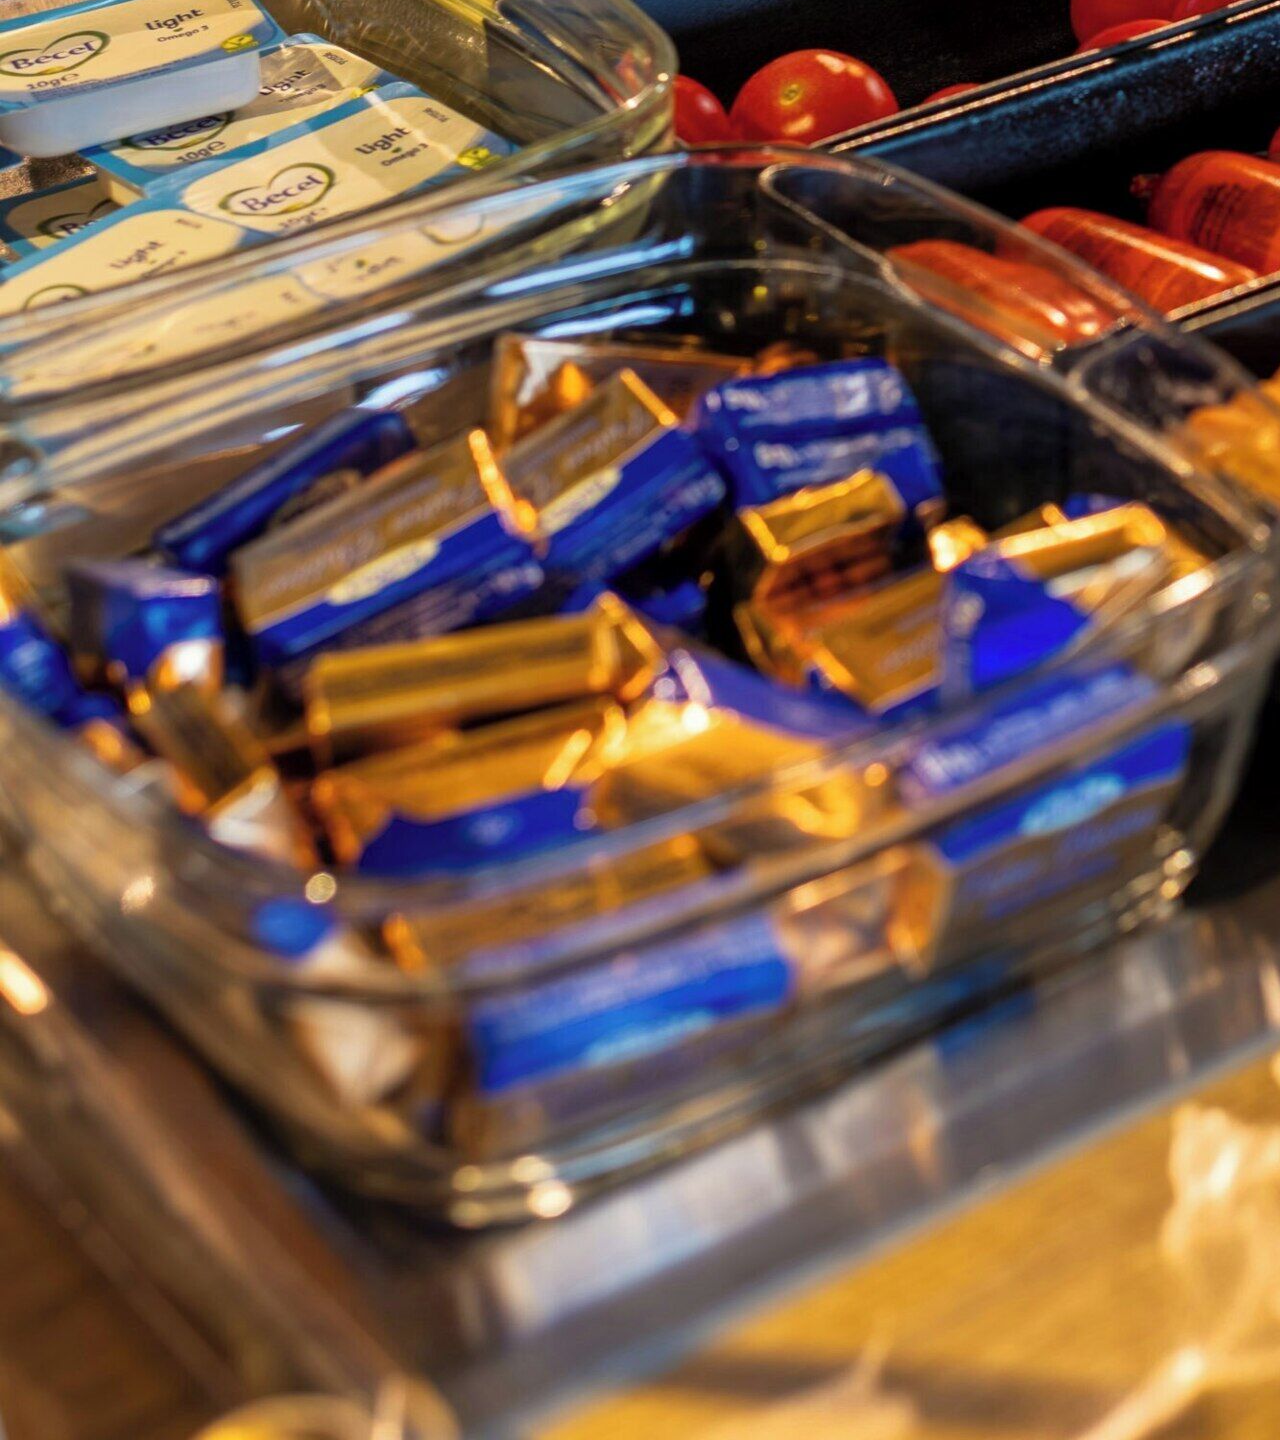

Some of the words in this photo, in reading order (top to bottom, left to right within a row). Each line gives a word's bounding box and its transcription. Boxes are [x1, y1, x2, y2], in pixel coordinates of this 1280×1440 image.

[145, 9, 204, 31] Light
[157, 28, 199, 43] Omega
[11, 40, 97, 70] Becel
[355, 127, 411, 155] Light
[241, 174, 325, 212] Becel
